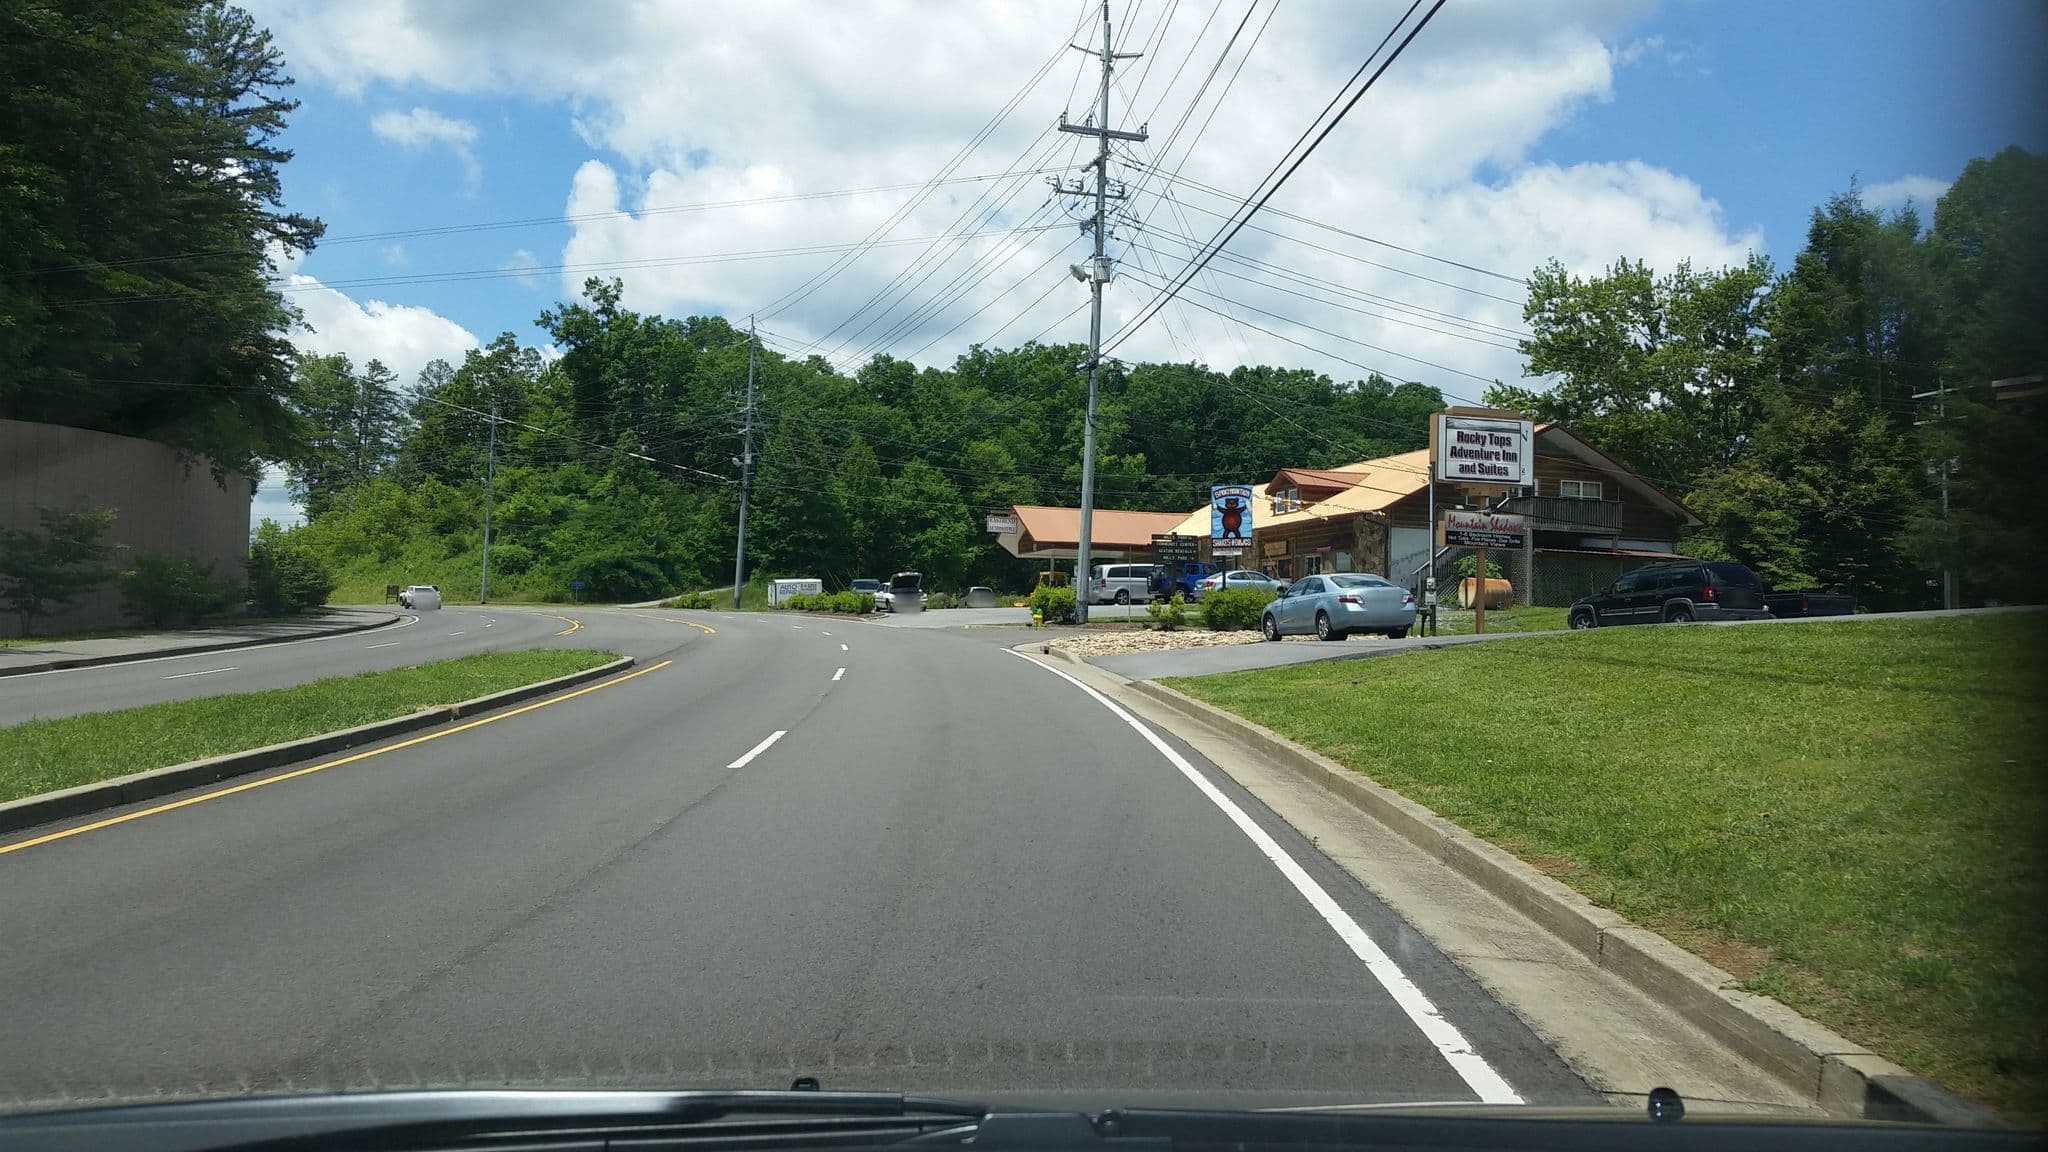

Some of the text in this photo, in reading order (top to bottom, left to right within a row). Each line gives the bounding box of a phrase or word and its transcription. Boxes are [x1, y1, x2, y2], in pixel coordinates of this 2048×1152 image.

[1456, 431, 1512, 448] Rocky Tops
[1449, 446, 1518, 463] Adventure Inn
[1458, 463, 1509, 476] and Suites
[1448, 513, 1487, 529] Mountain
